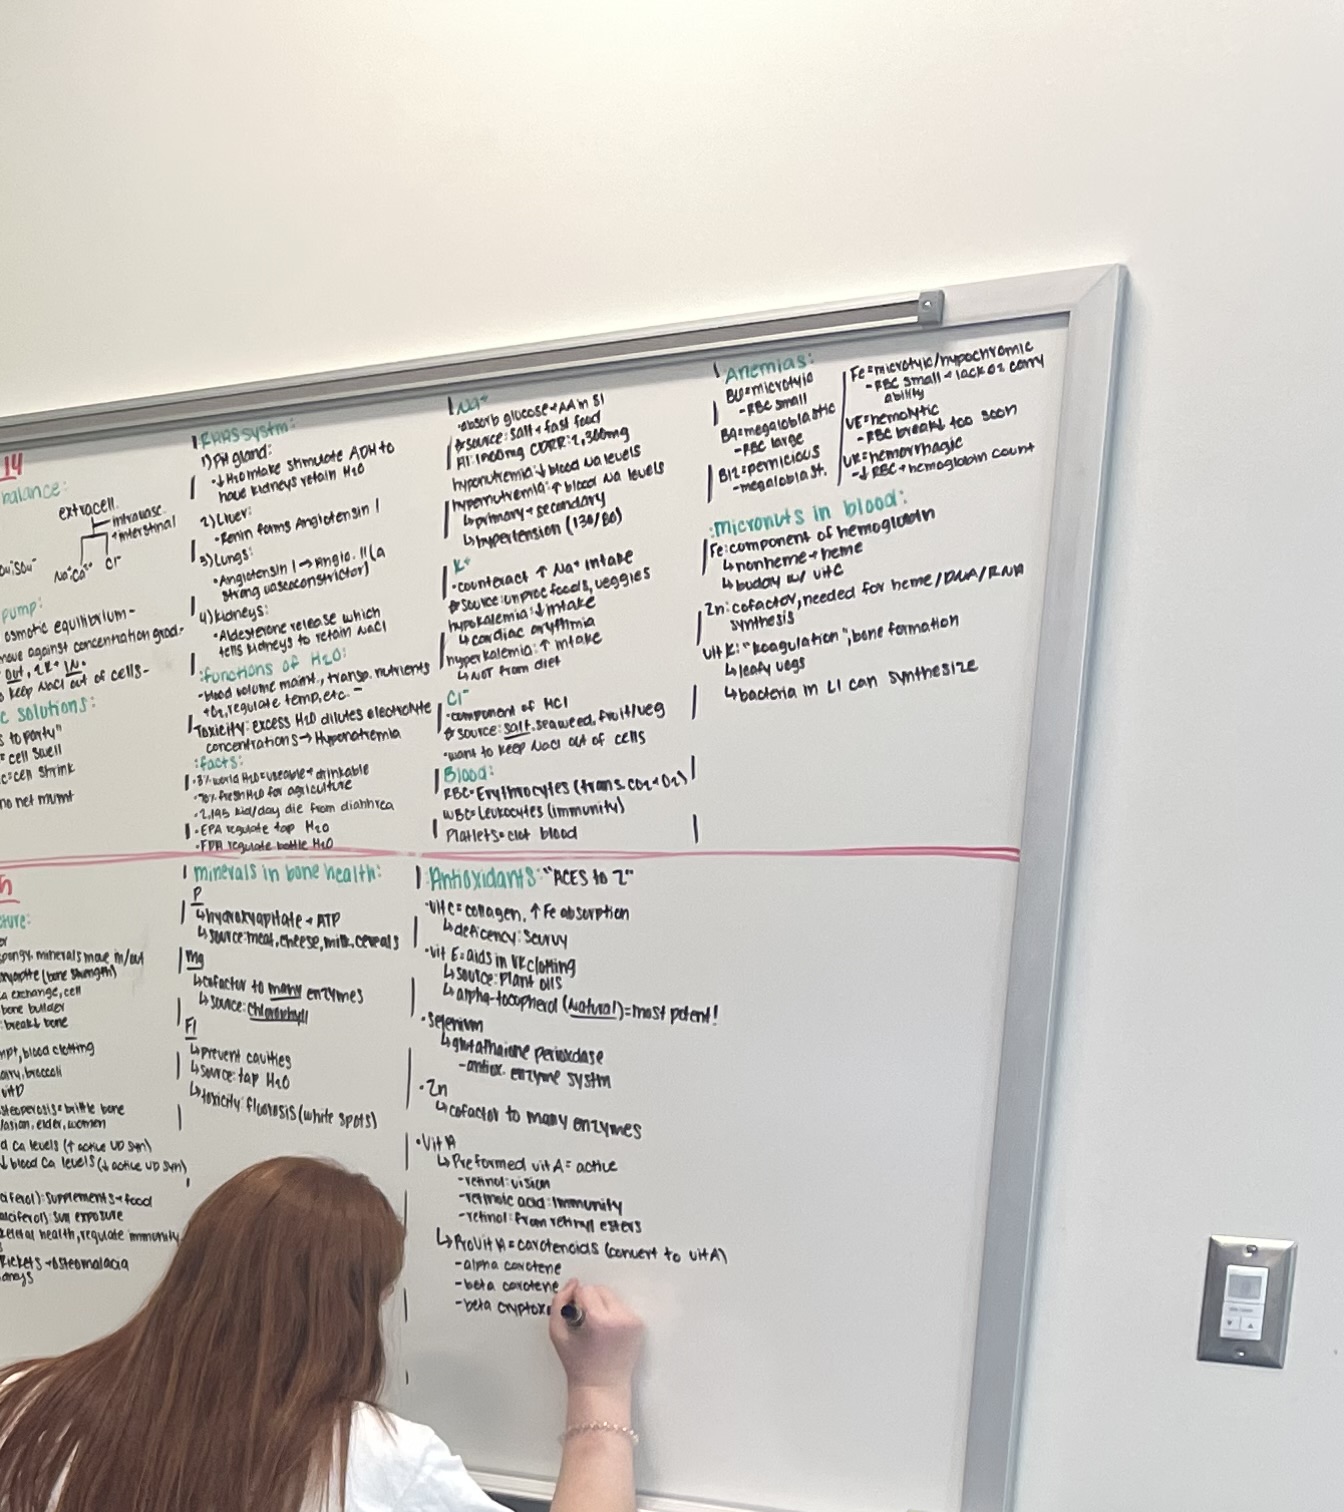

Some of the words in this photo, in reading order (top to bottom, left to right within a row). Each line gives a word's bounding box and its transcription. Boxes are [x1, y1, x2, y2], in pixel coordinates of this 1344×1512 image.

[903, 371, 941, 387] small
[775, 392, 807, 411] small
[544, 416, 569, 433] fast
[574, 410, 601, 428] food
[949, 416, 973, 429] too
[981, 404, 1017, 421] soon
[349, 443, 377, 460] ADH
[379, 440, 395, 454] to
[992, 442, 1035, 459] count
[5, 453, 22, 475] 14
[548, 459, 580, 476] blood
[604, 444, 641, 464] levels
[564, 476, 597, 493] blood
[628, 461, 664, 481] levels
[218, 487, 246, 503] have
[250, 476, 297, 496] kidneys
[300, 470, 336, 487] retain
[536, 491, 606, 518] secondary
[813, 505, 831, 521] in
[817, 525, 833, 542] of
[290, 613, 337, 631] release
[342, 607, 380, 624] which
[888, 615, 959, 636] formation
[28, 641, 68, 661] against
[74, 628, 150, 653] concentration
[219, 644, 243, 658] tells
[298, 634, 311, 646] to
[316, 626, 351, 643] retain
[283, 655, 299, 672] of
[374, 661, 430, 678] nutrients
[499, 665, 529, 676] from
[534, 655, 561, 670] diet
[70, 672, 87, 689] out
[94, 669, 105, 684] of
[802, 684, 818, 697] in
[849, 676, 878, 691] can
[888, 659, 979, 686] synthesize
[521, 700, 535, 712] of
[252, 716, 291, 734] excess
[321, 708, 363, 725] dilutes
[481, 746, 494, 758] to
[592, 732, 605, 746] of
[615, 730, 646, 745] cells
[288, 781, 352, 798] agriculture
[15, 794, 34, 808] net
[285, 803, 303, 814] die
[310, 802, 335, 814] from
[539, 826, 577, 840] blood
[262, 865, 279, 882] in
[286, 864, 319, 882] bone
[317, 912, 340, 928] ATP
[544, 903, 556, 919] Fe
[560, 904, 629, 921] absorption
[251, 979, 264, 994] to
[238, 1067, 259, 1088] tap
[505, 1105, 521, 1123] to
[573, 1117, 642, 1140] enzymes
[29, 1139, 59, 1152] levels
[10, 1157, 38, 1170] blood
[61, 1154, 95, 1170] levels
[664, 1246, 681, 1263] to
[504, 1260, 561, 1275] carotene
[502, 1280, 559, 1294] carotene
